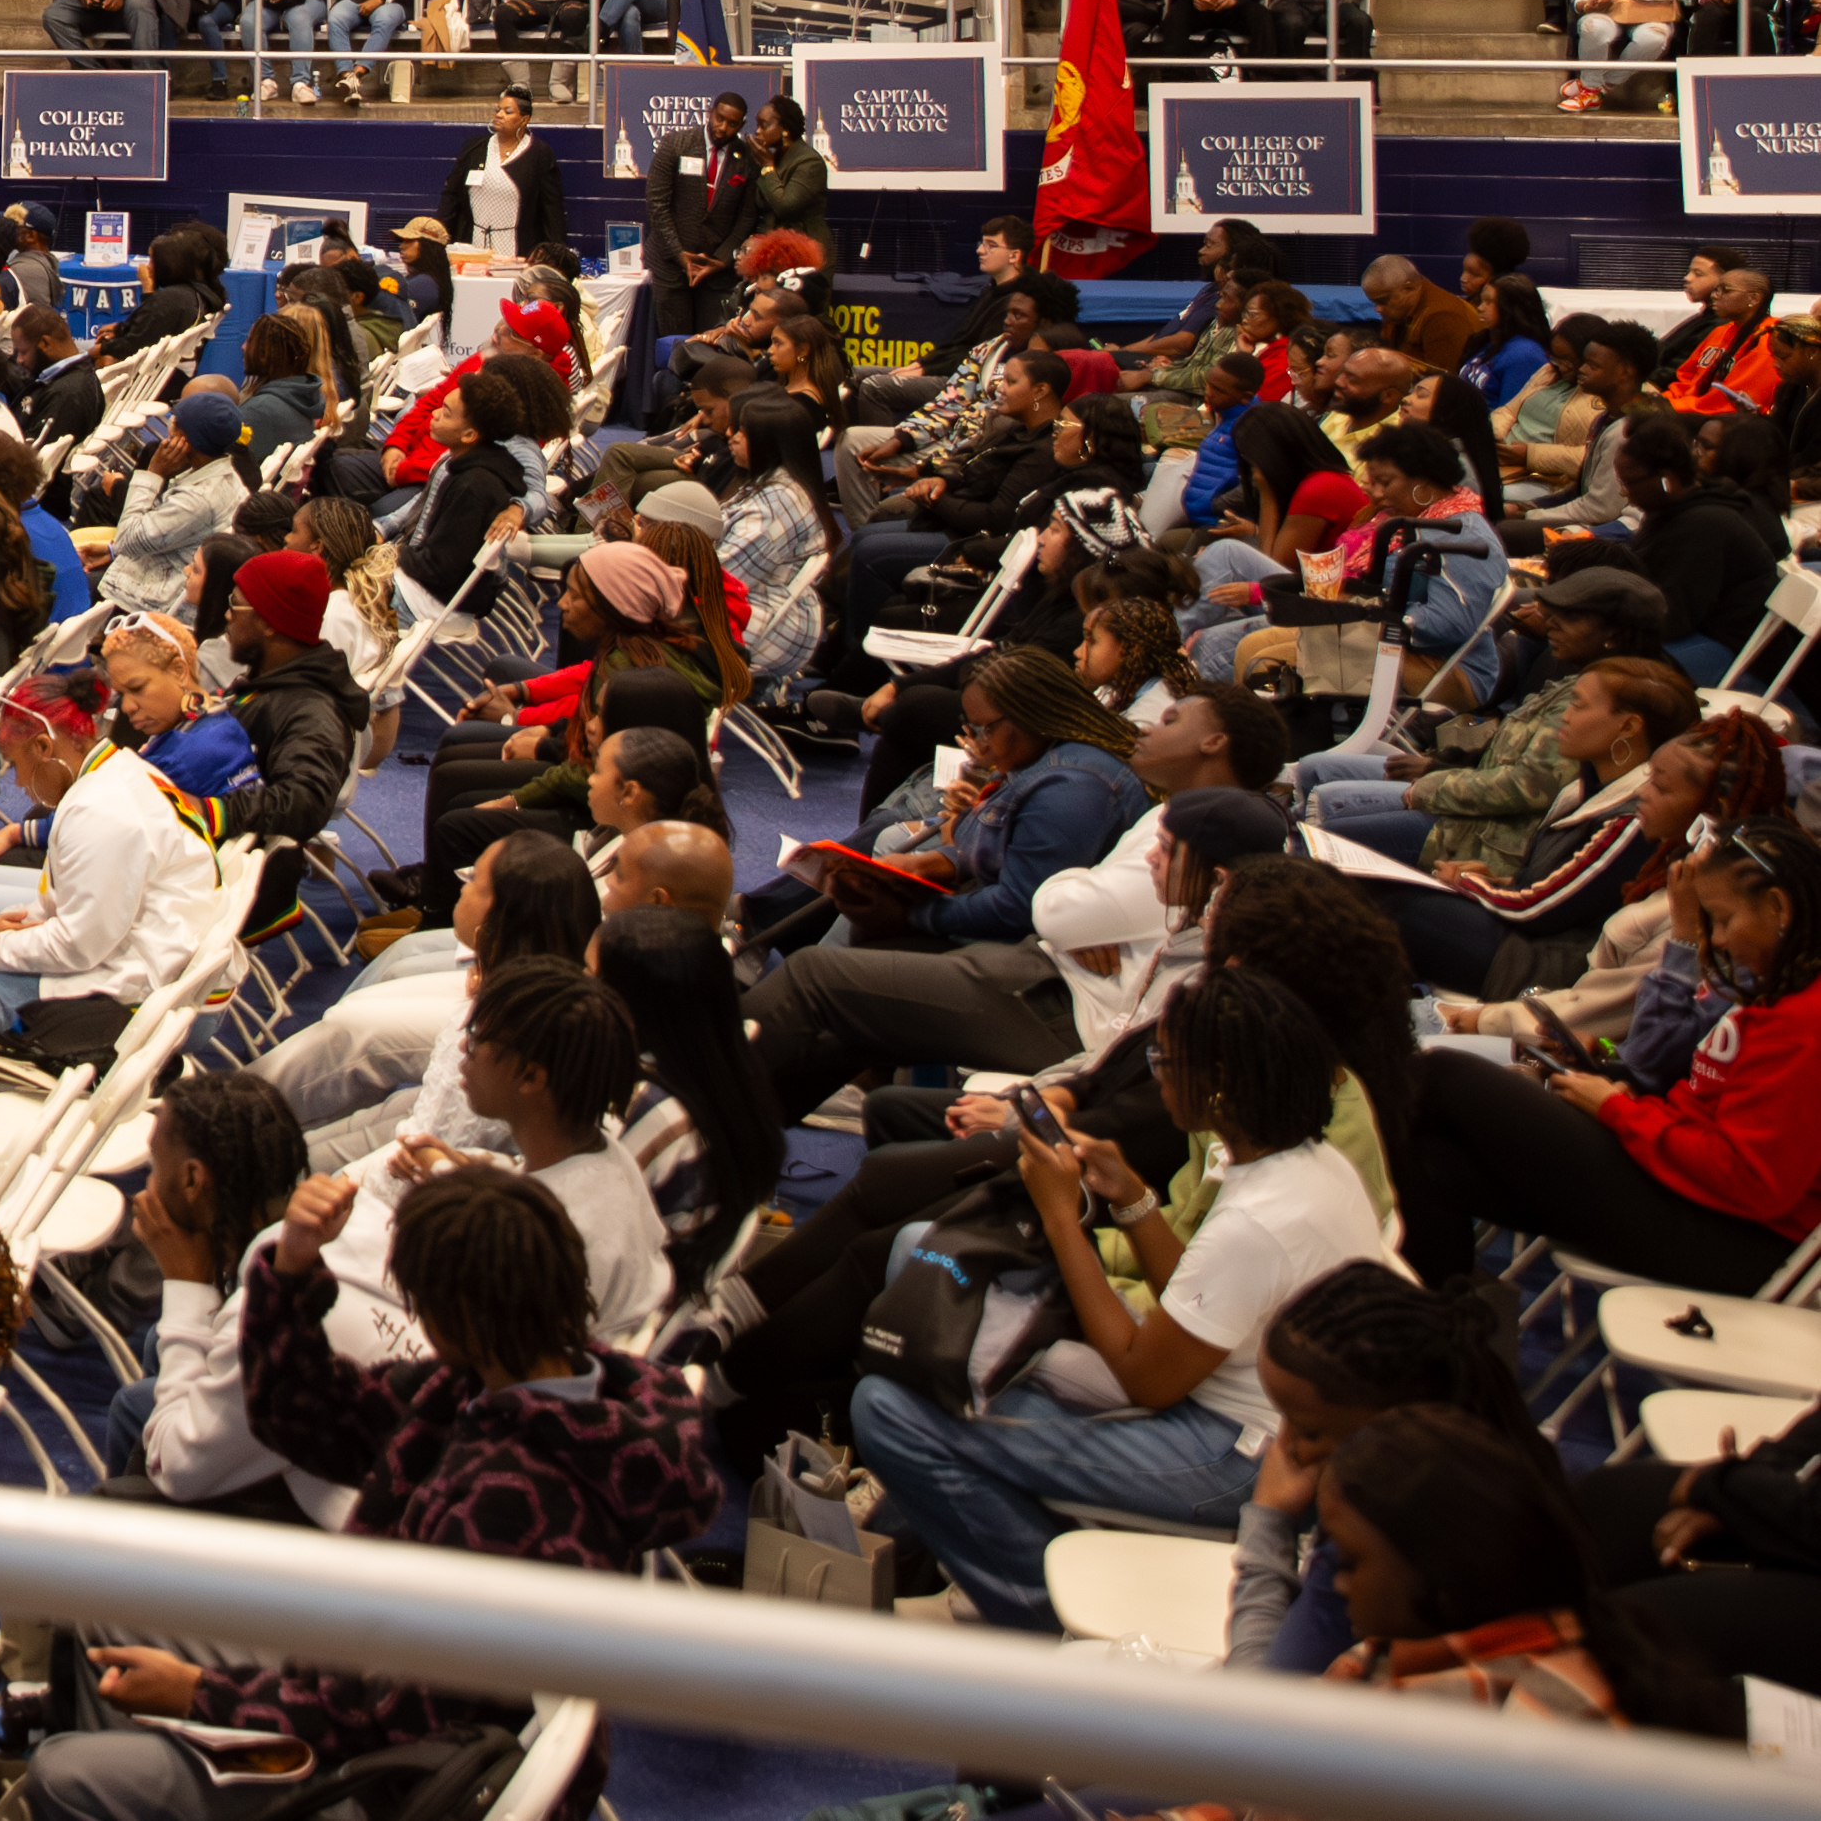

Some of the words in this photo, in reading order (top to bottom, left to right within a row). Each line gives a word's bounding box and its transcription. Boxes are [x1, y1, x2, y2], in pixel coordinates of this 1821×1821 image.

[758, 44, 785, 57] THE
[853, 88, 934, 104] CAPITAL
[642, 110, 710, 126] MILITAR
[840, 103, 949, 119] BATTALION
[39, 111, 125, 128] COLLEGE
[840, 118, 895, 133] NAVY
[896, 118, 949, 133] ROTC
[69, 126, 96, 142] OF
[28, 140, 136, 158] PHARMACY
[1200, 135, 1294, 151] COLLEGE
[1295, 135, 1326, 151] OF
[1227, 150, 1299, 166] ALLIED
[1038, 165, 1065, 187] TES
[1222, 165, 1306, 181] HEALTH
[1216, 180, 1313, 197] SCIENCES
[1050, 232, 1086, 254] ORPS
[71, 287, 137, 309] WAR
[828, 305, 883, 335] OTC
[450, 344, 472, 356] for
[844, 339, 936, 369] RSHIPS
